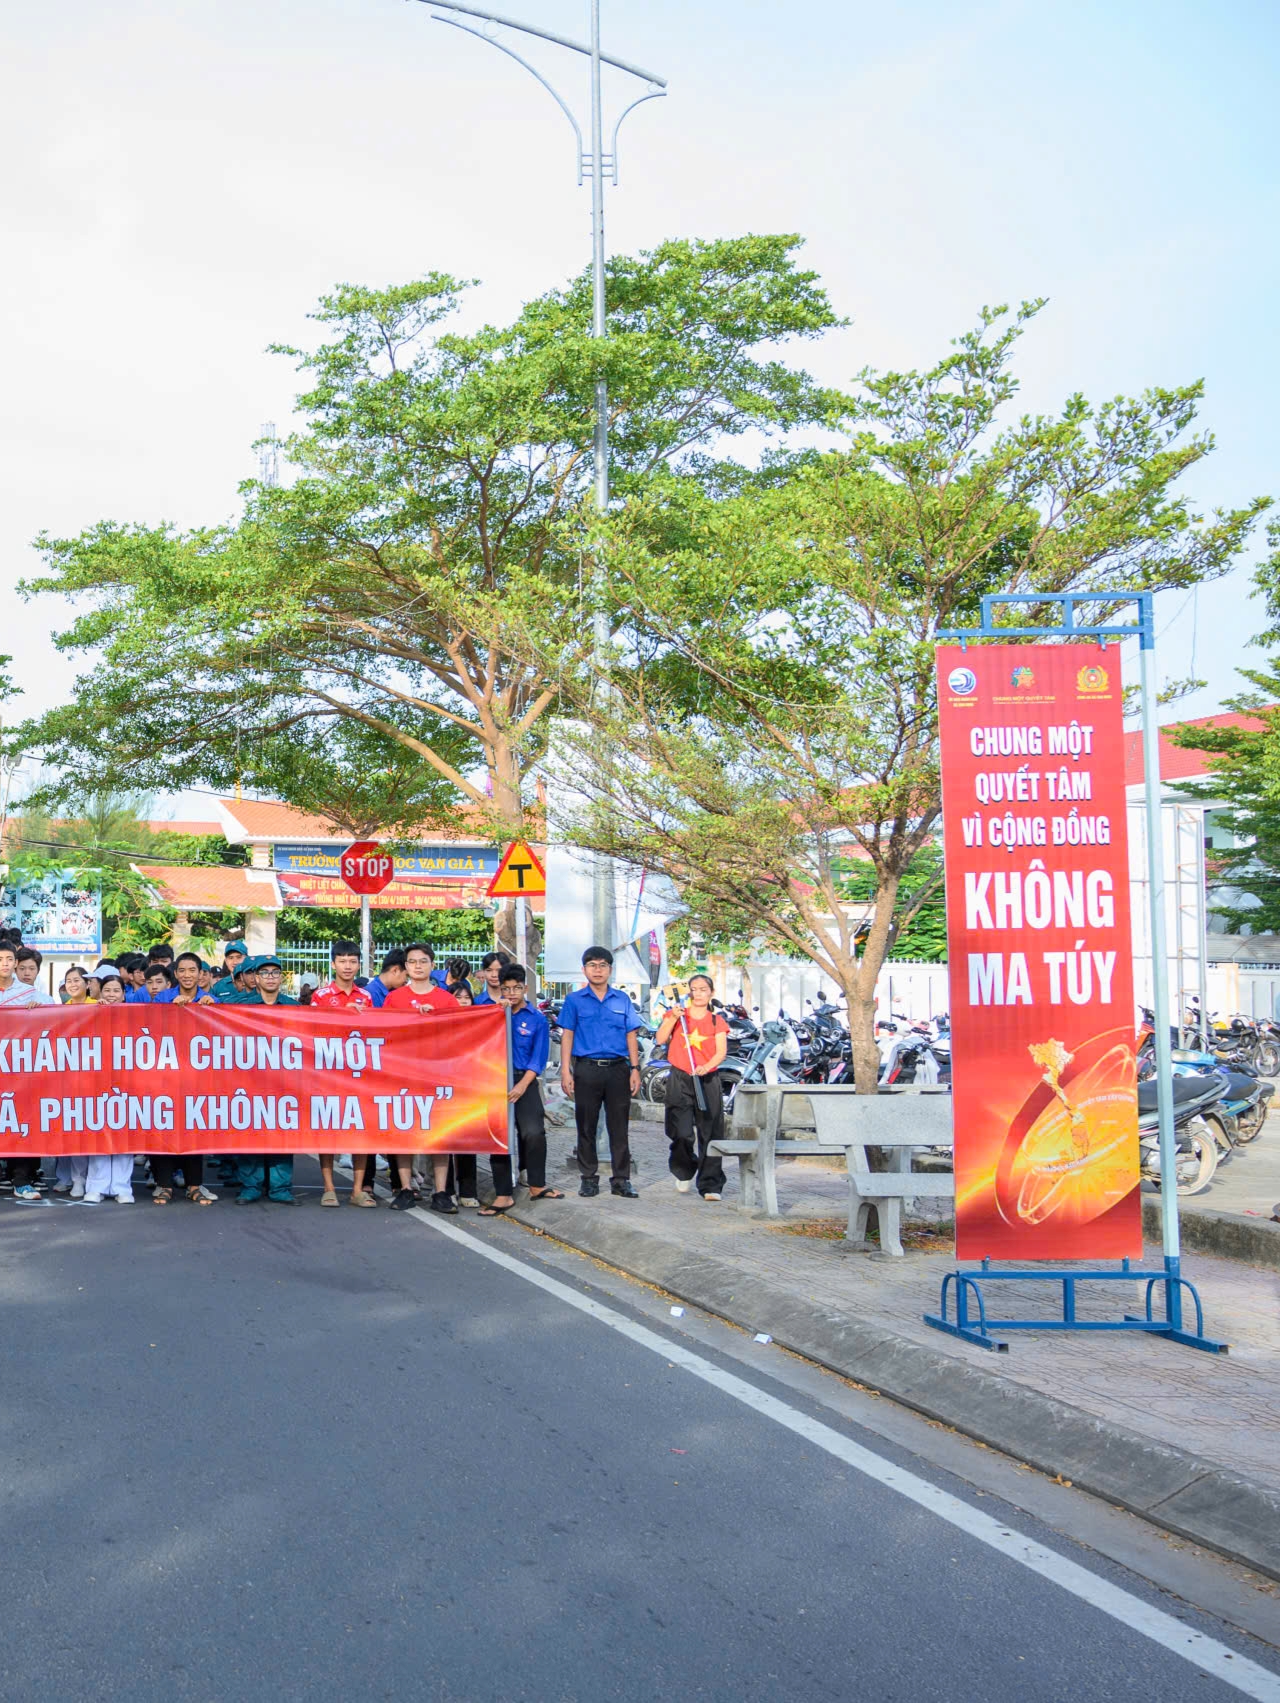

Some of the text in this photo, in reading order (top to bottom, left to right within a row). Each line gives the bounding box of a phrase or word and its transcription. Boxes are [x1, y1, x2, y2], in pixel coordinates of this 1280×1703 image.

[970, 720, 1094, 761] CHUNG MỘT
[975, 764, 1092, 805] QUYẾT TÂM
[961, 807, 1110, 853] VÌ CỘNG ĐỒNG
[345, 857, 389, 877] STOP
[418, 858, 446, 872] VẠN
[478, 858, 485, 870] 1
[964, 858, 1115, 930] KHÔNG
[967, 940, 1117, 1006] MA TÚY
[112, 1027, 179, 1071] HÒA
[189, 1035, 303, 1071] CHUNG
[313, 1030, 385, 1078] MỘT
[39, 1087, 174, 1132] PHƯỜNG
[184, 1088, 299, 1130] KHÔNG
[310, 1095, 365, 1130] MA
[373, 1086, 454, 1130] TÚY”
